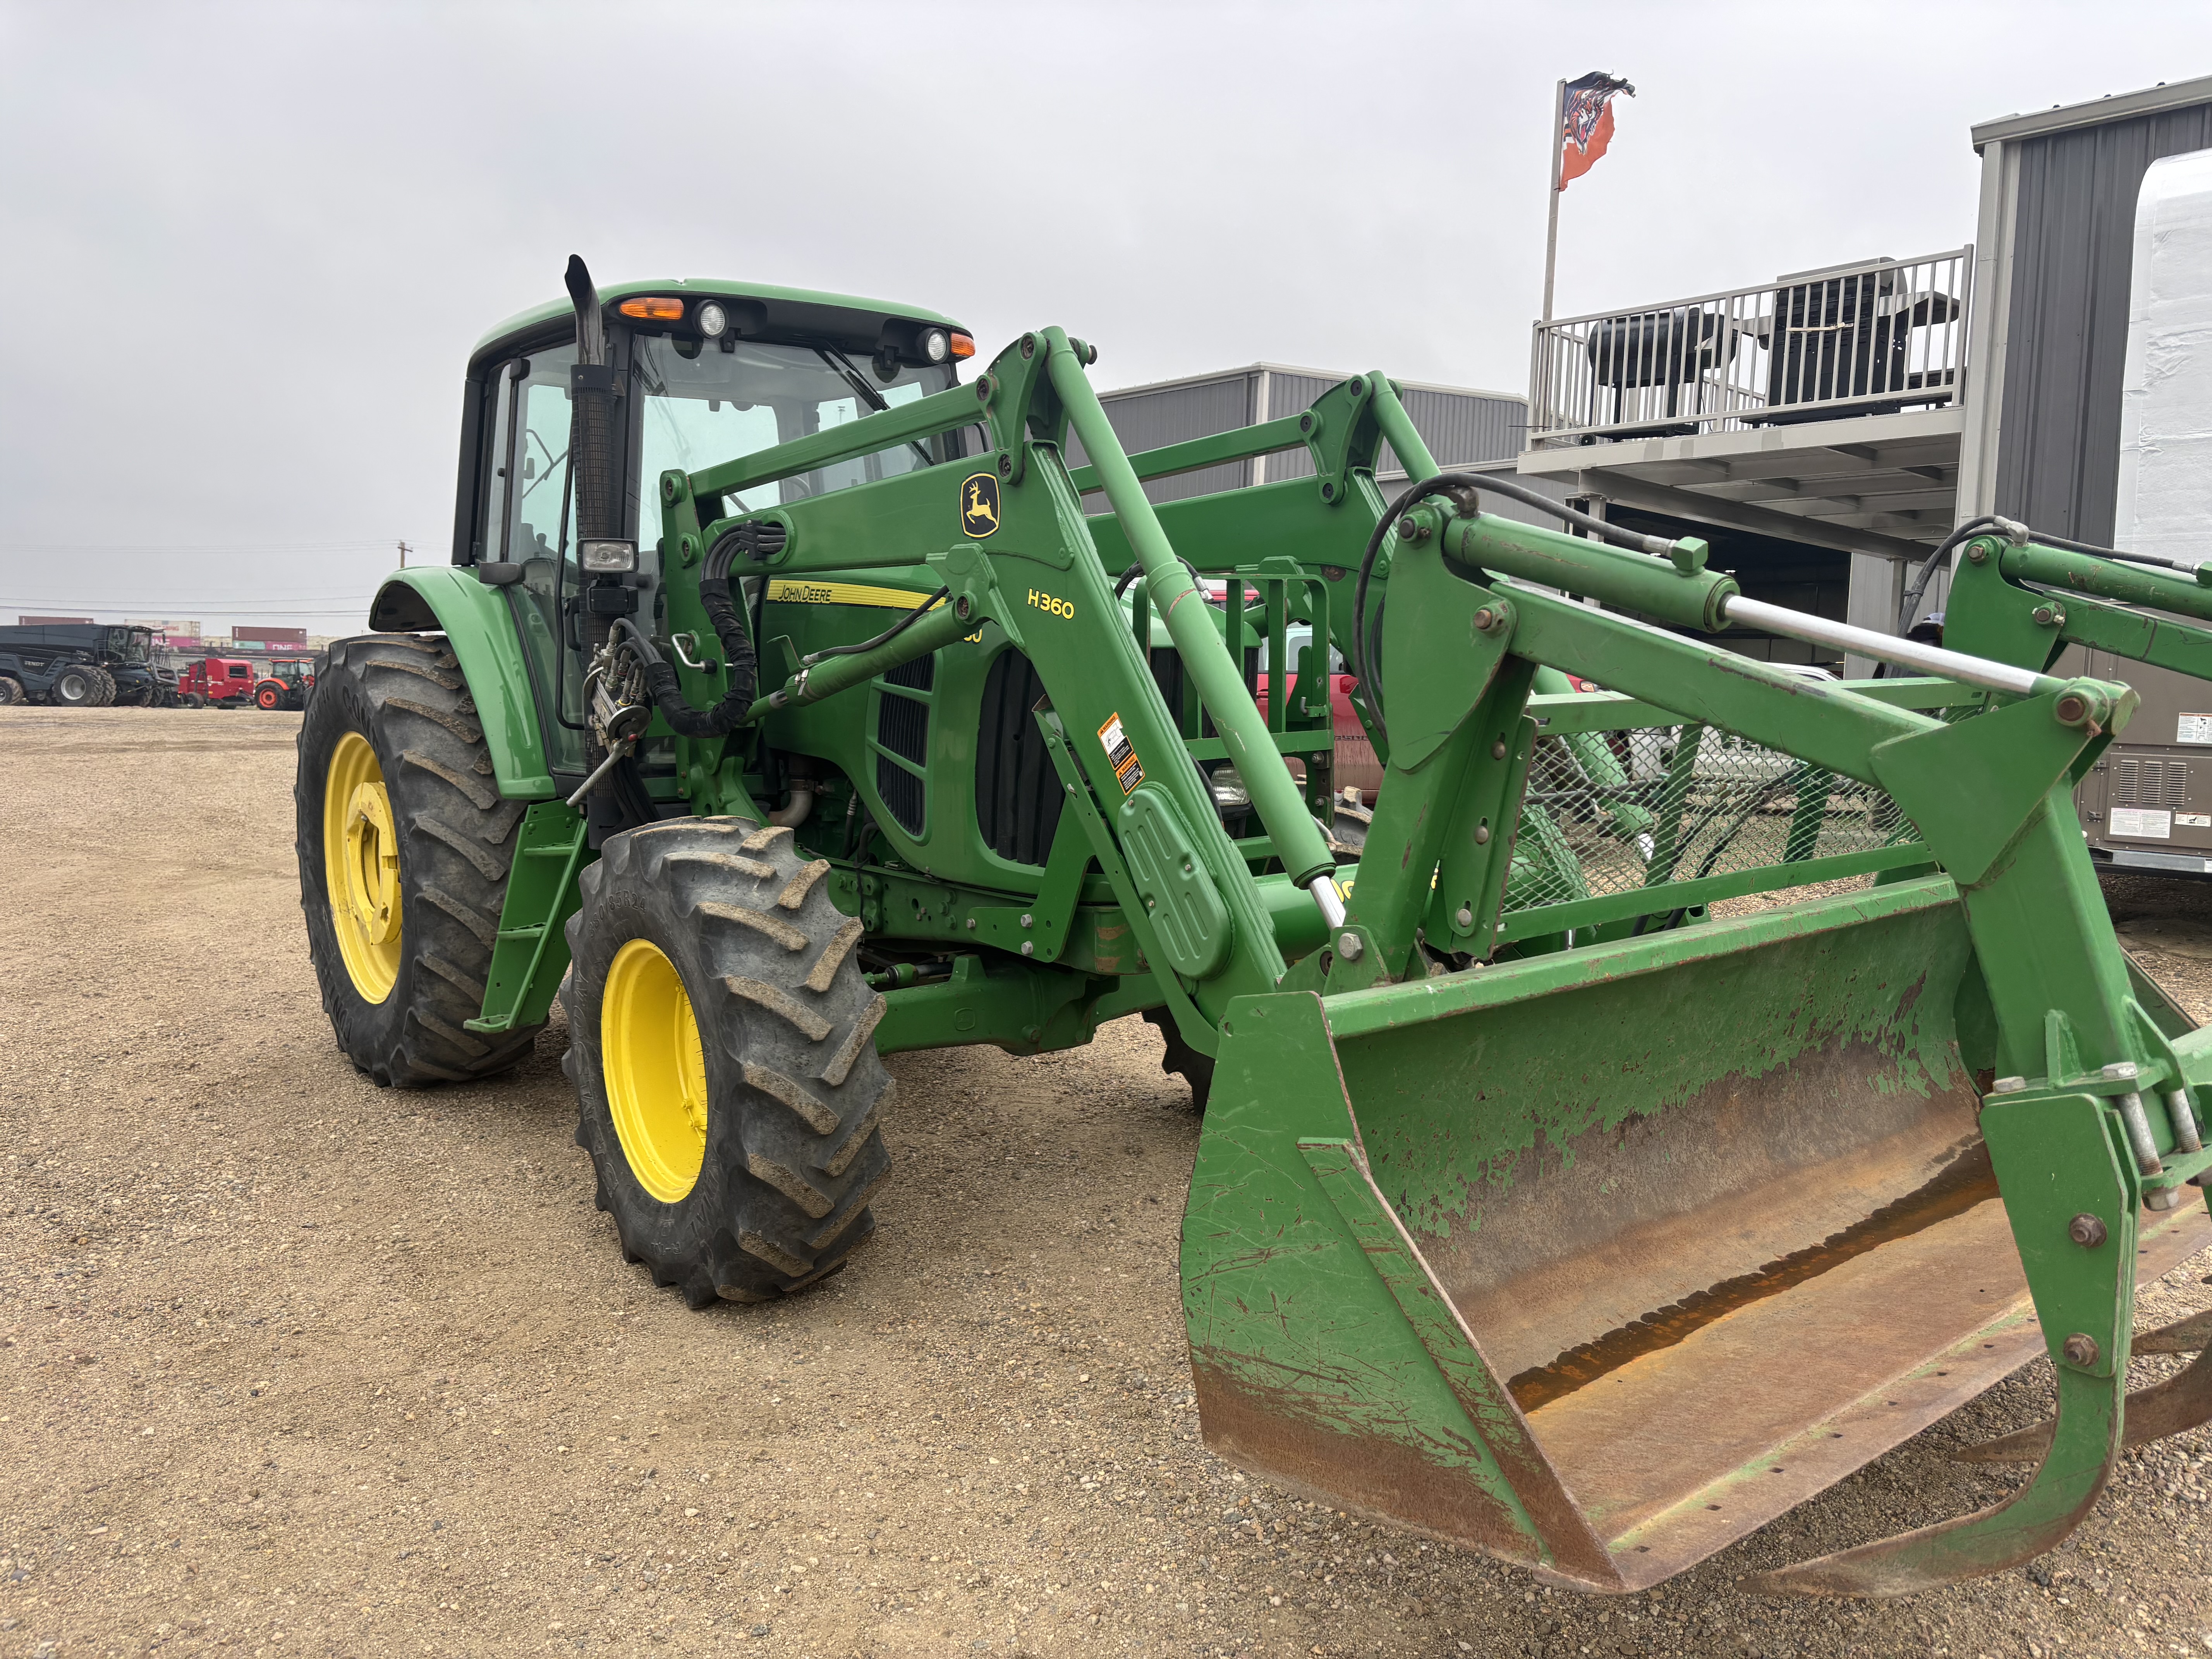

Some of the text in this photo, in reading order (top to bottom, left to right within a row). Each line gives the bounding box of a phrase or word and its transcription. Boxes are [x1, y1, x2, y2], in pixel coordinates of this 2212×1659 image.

[778, 585, 832, 601] JOHN DEERE
[1027, 588, 1075, 620] H360
[589, 890, 646, 939] 380/85R24
